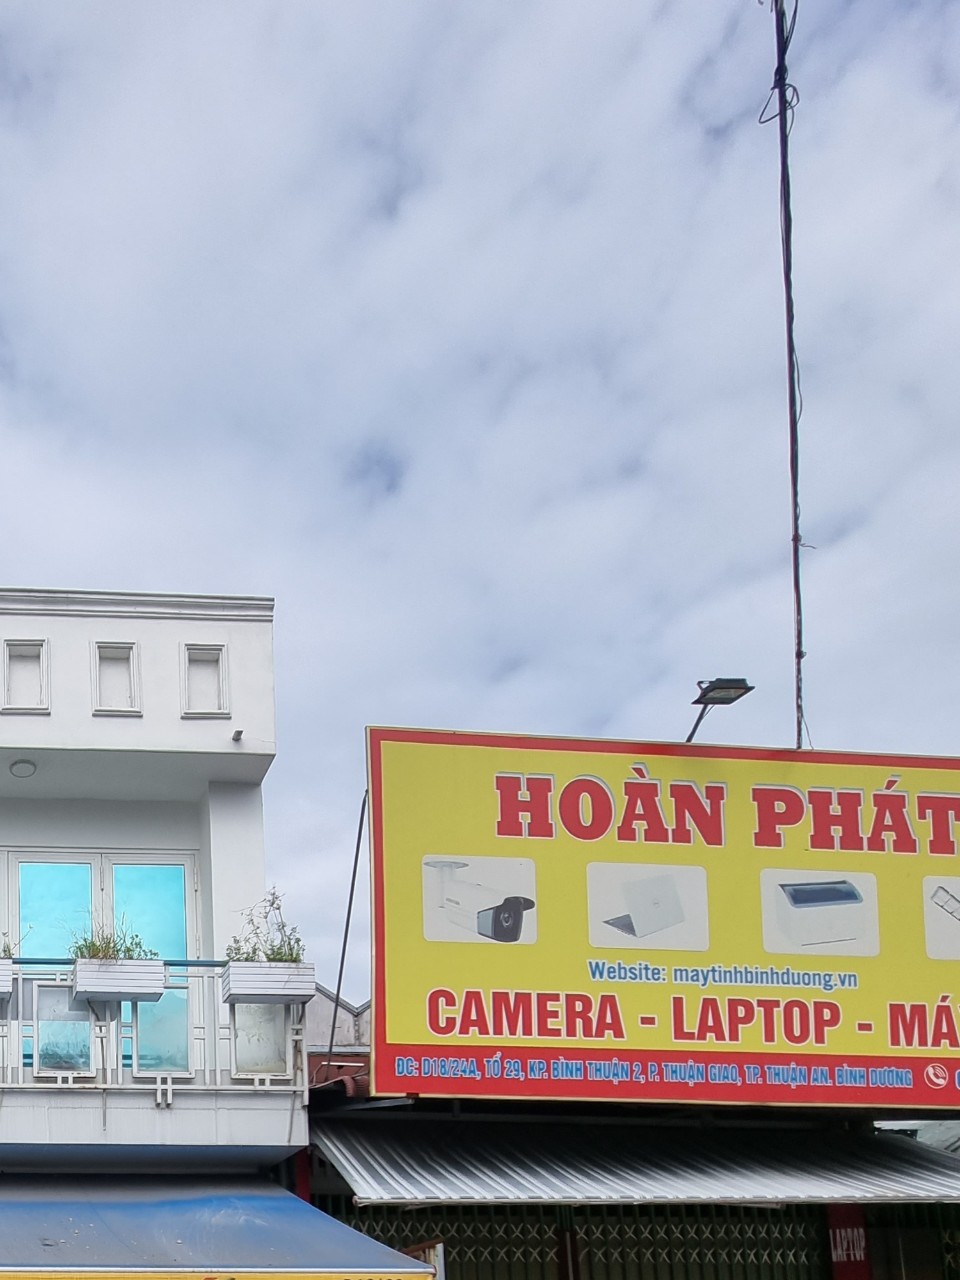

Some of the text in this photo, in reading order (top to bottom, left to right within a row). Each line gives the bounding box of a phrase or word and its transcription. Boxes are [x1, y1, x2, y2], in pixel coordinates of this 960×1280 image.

[495, 762, 960, 856] HOÀN PHÁT
[587, 960, 858, 991] Website: maytinhbinhduong.vn
[426, 987, 627, 1041] CAMERA
[671, 995, 842, 1046] LAPTOP
[888, 994, 960, 1048] MÁ
[396, 1051, 914, 1089] ĐC: D18/24A, TỔ 29, KP. BÌNH THUẬN 2, P. THUẬN GIAO, TP. THUẬN AN. BÌNH DƯƠNG
[829, 1227, 866, 1262] LAPTOP
